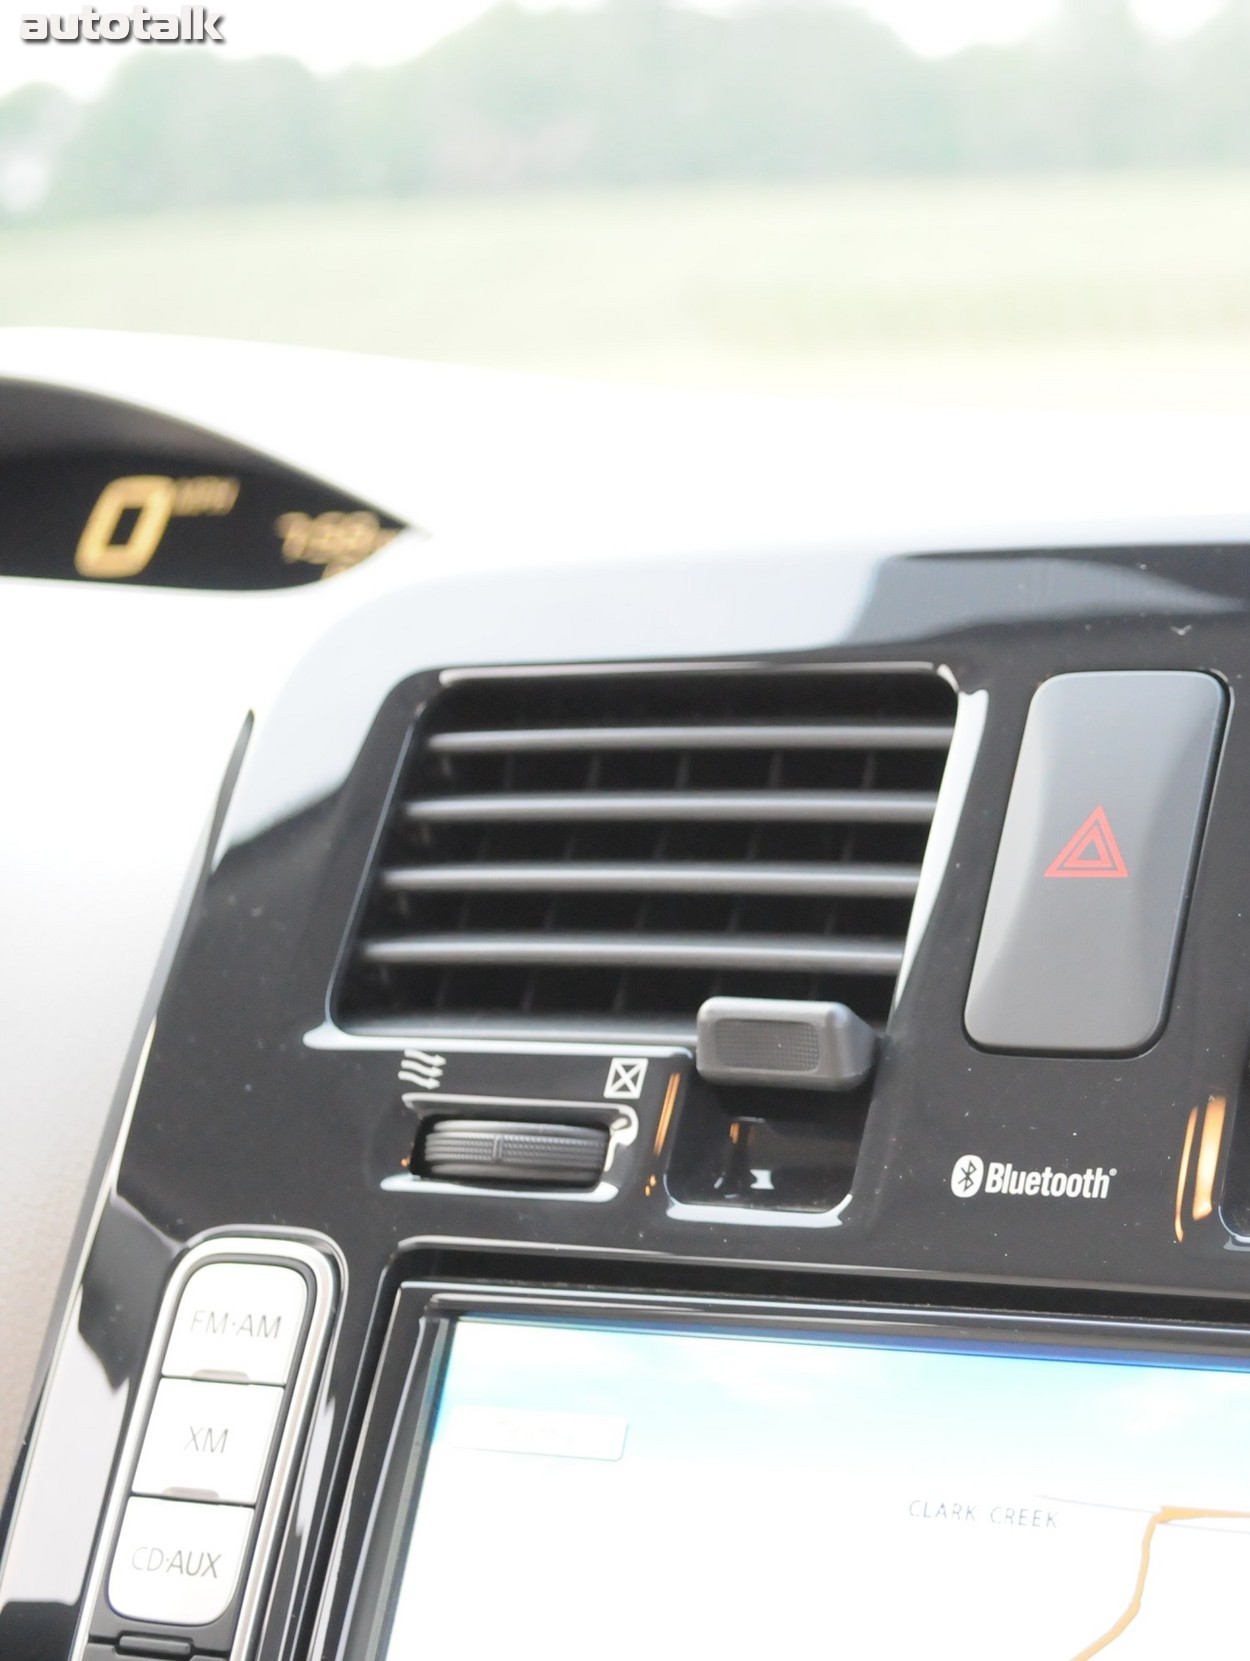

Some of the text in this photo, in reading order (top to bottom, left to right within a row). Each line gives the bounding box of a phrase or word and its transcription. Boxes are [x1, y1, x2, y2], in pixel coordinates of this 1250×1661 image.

[75, 475, 174, 578] 0
[184, 1425, 229, 1455] XM
[908, 1499, 1057, 1528] CLARK CREEK
